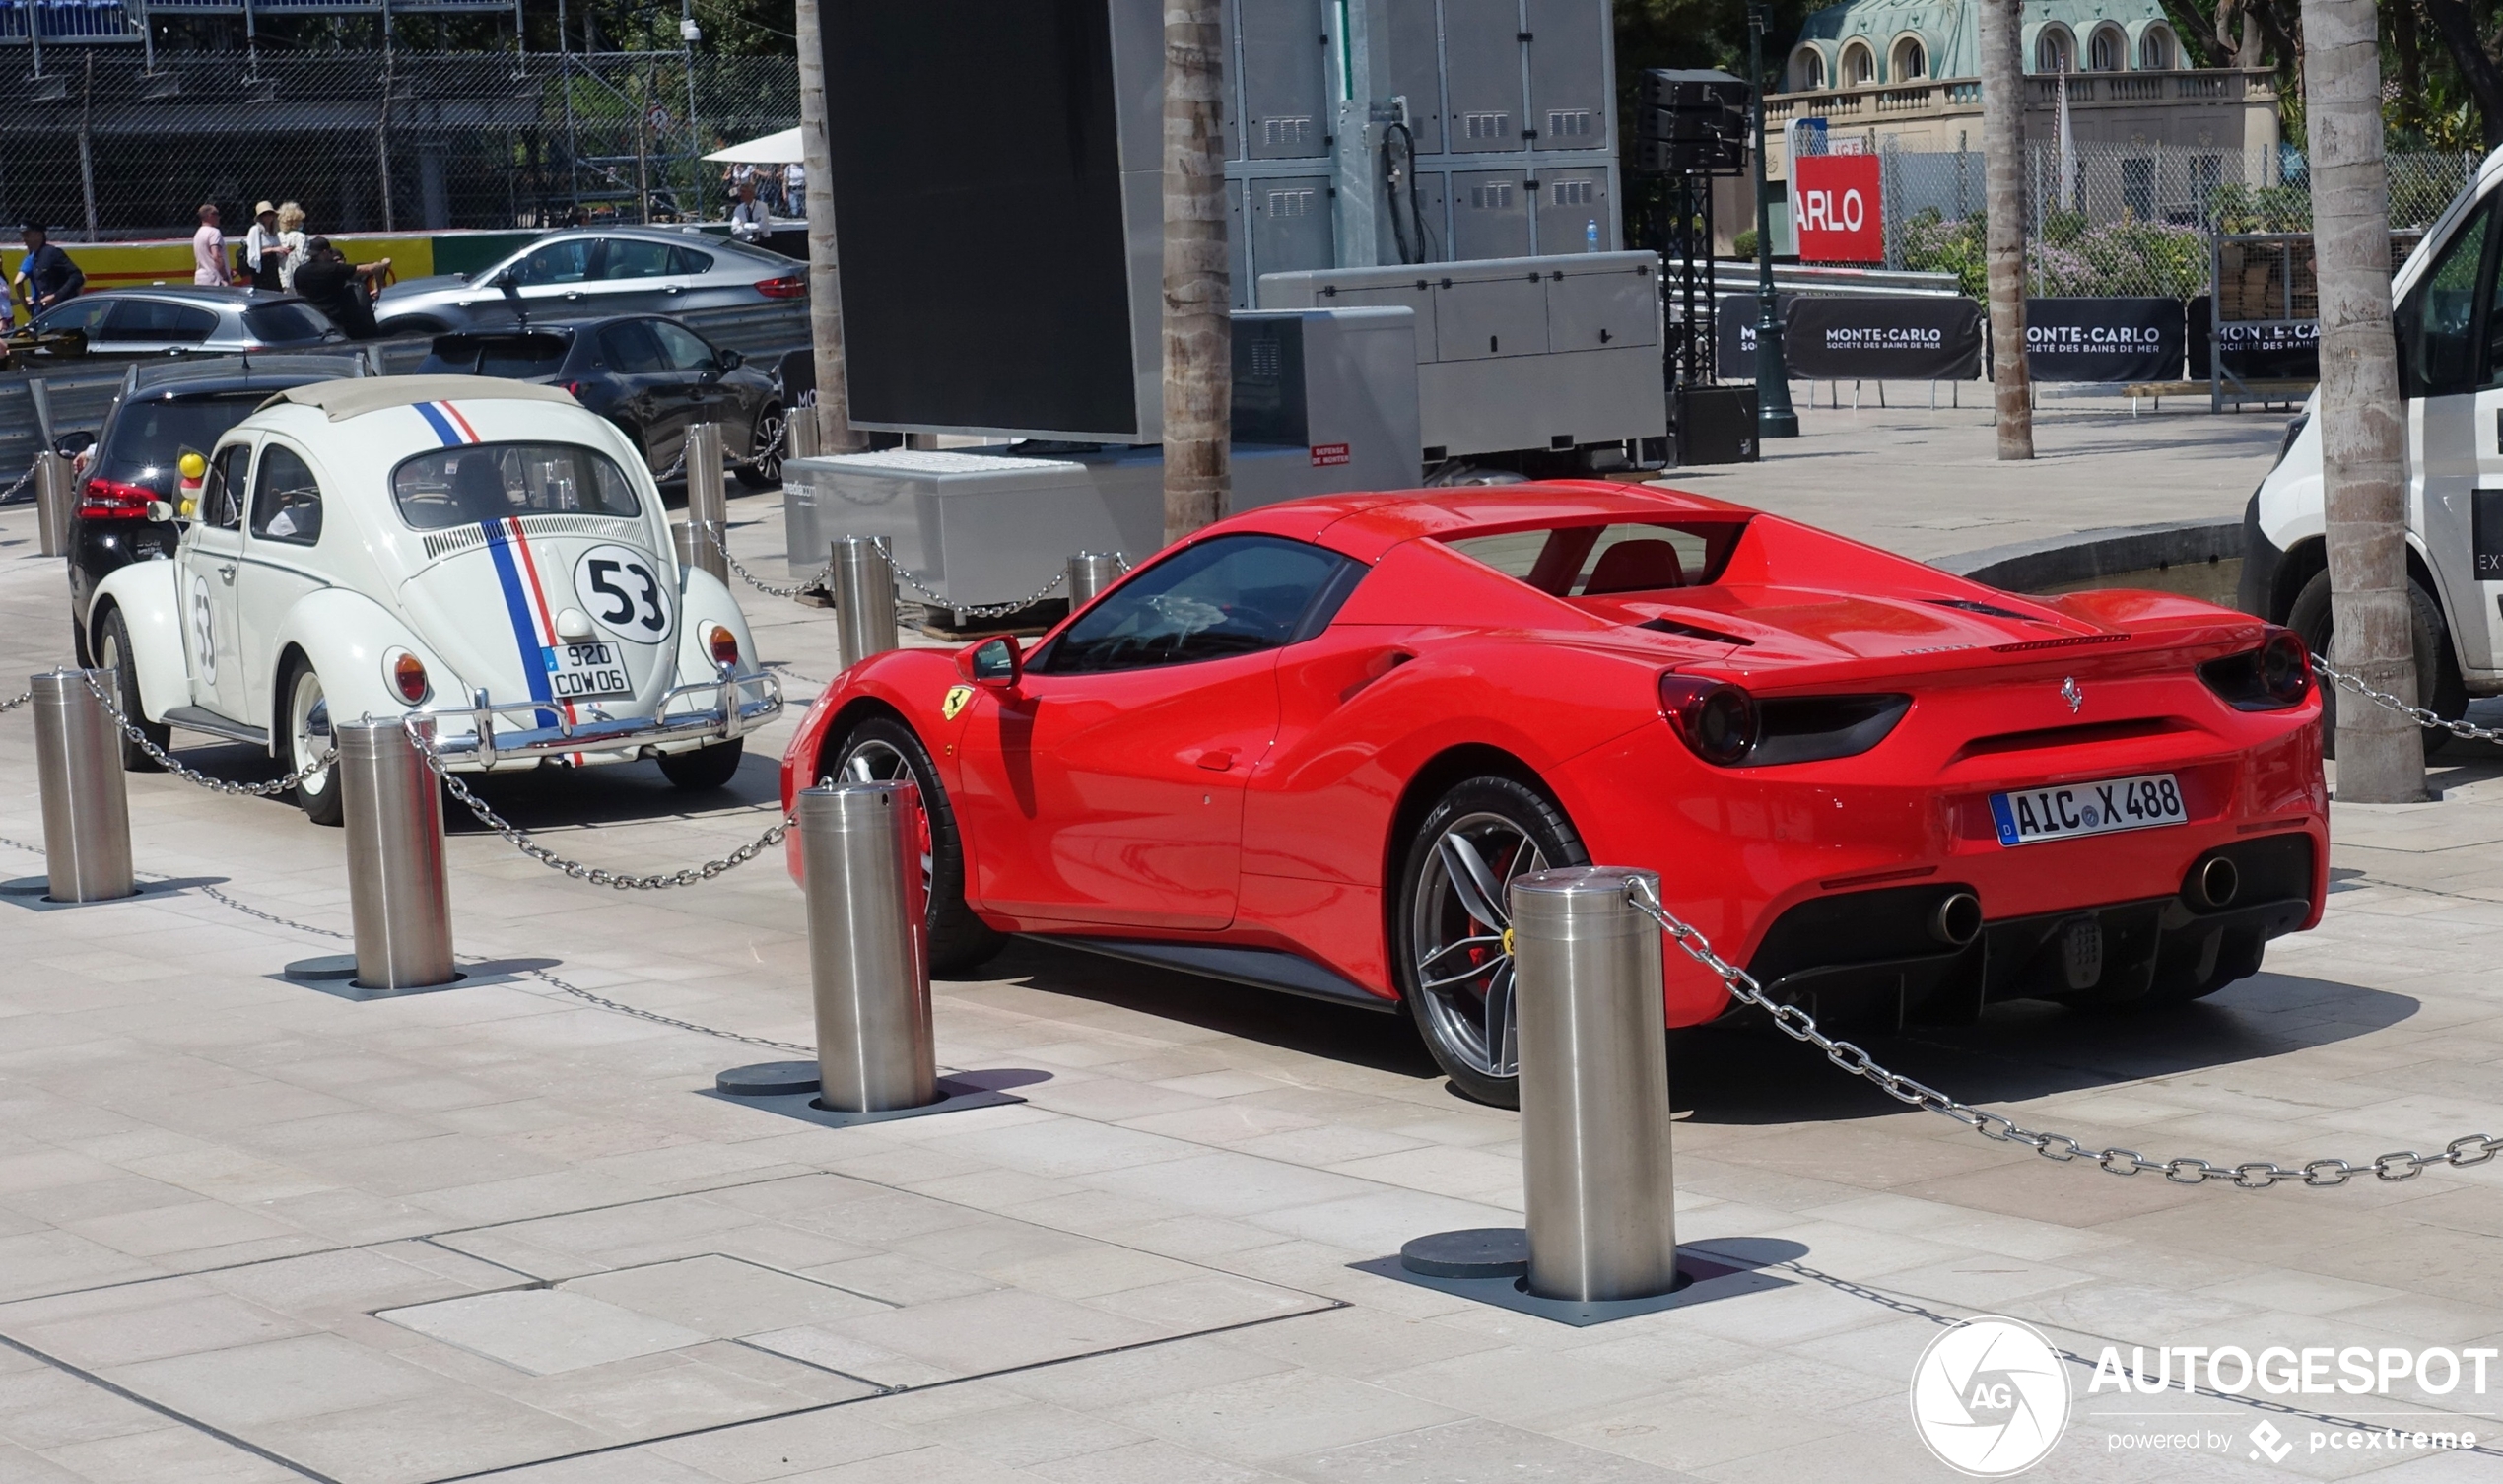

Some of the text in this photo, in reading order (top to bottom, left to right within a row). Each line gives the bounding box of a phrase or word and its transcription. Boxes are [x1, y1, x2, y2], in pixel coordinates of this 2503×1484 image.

[2059, 343, 2079, 353] DES
[2083, 343, 2116, 353] BAINS
[2120, 343, 2133, 353] DE
[2137, 344, 2160, 353] MER
[2262, 341, 2283, 350] DES
[588, 559, 665, 632] 53
[196, 594, 215, 669] 53
[567, 644, 612, 667] 920
[2017, 790, 2080, 835] AIC
[2002, 824, 2012, 836] D
